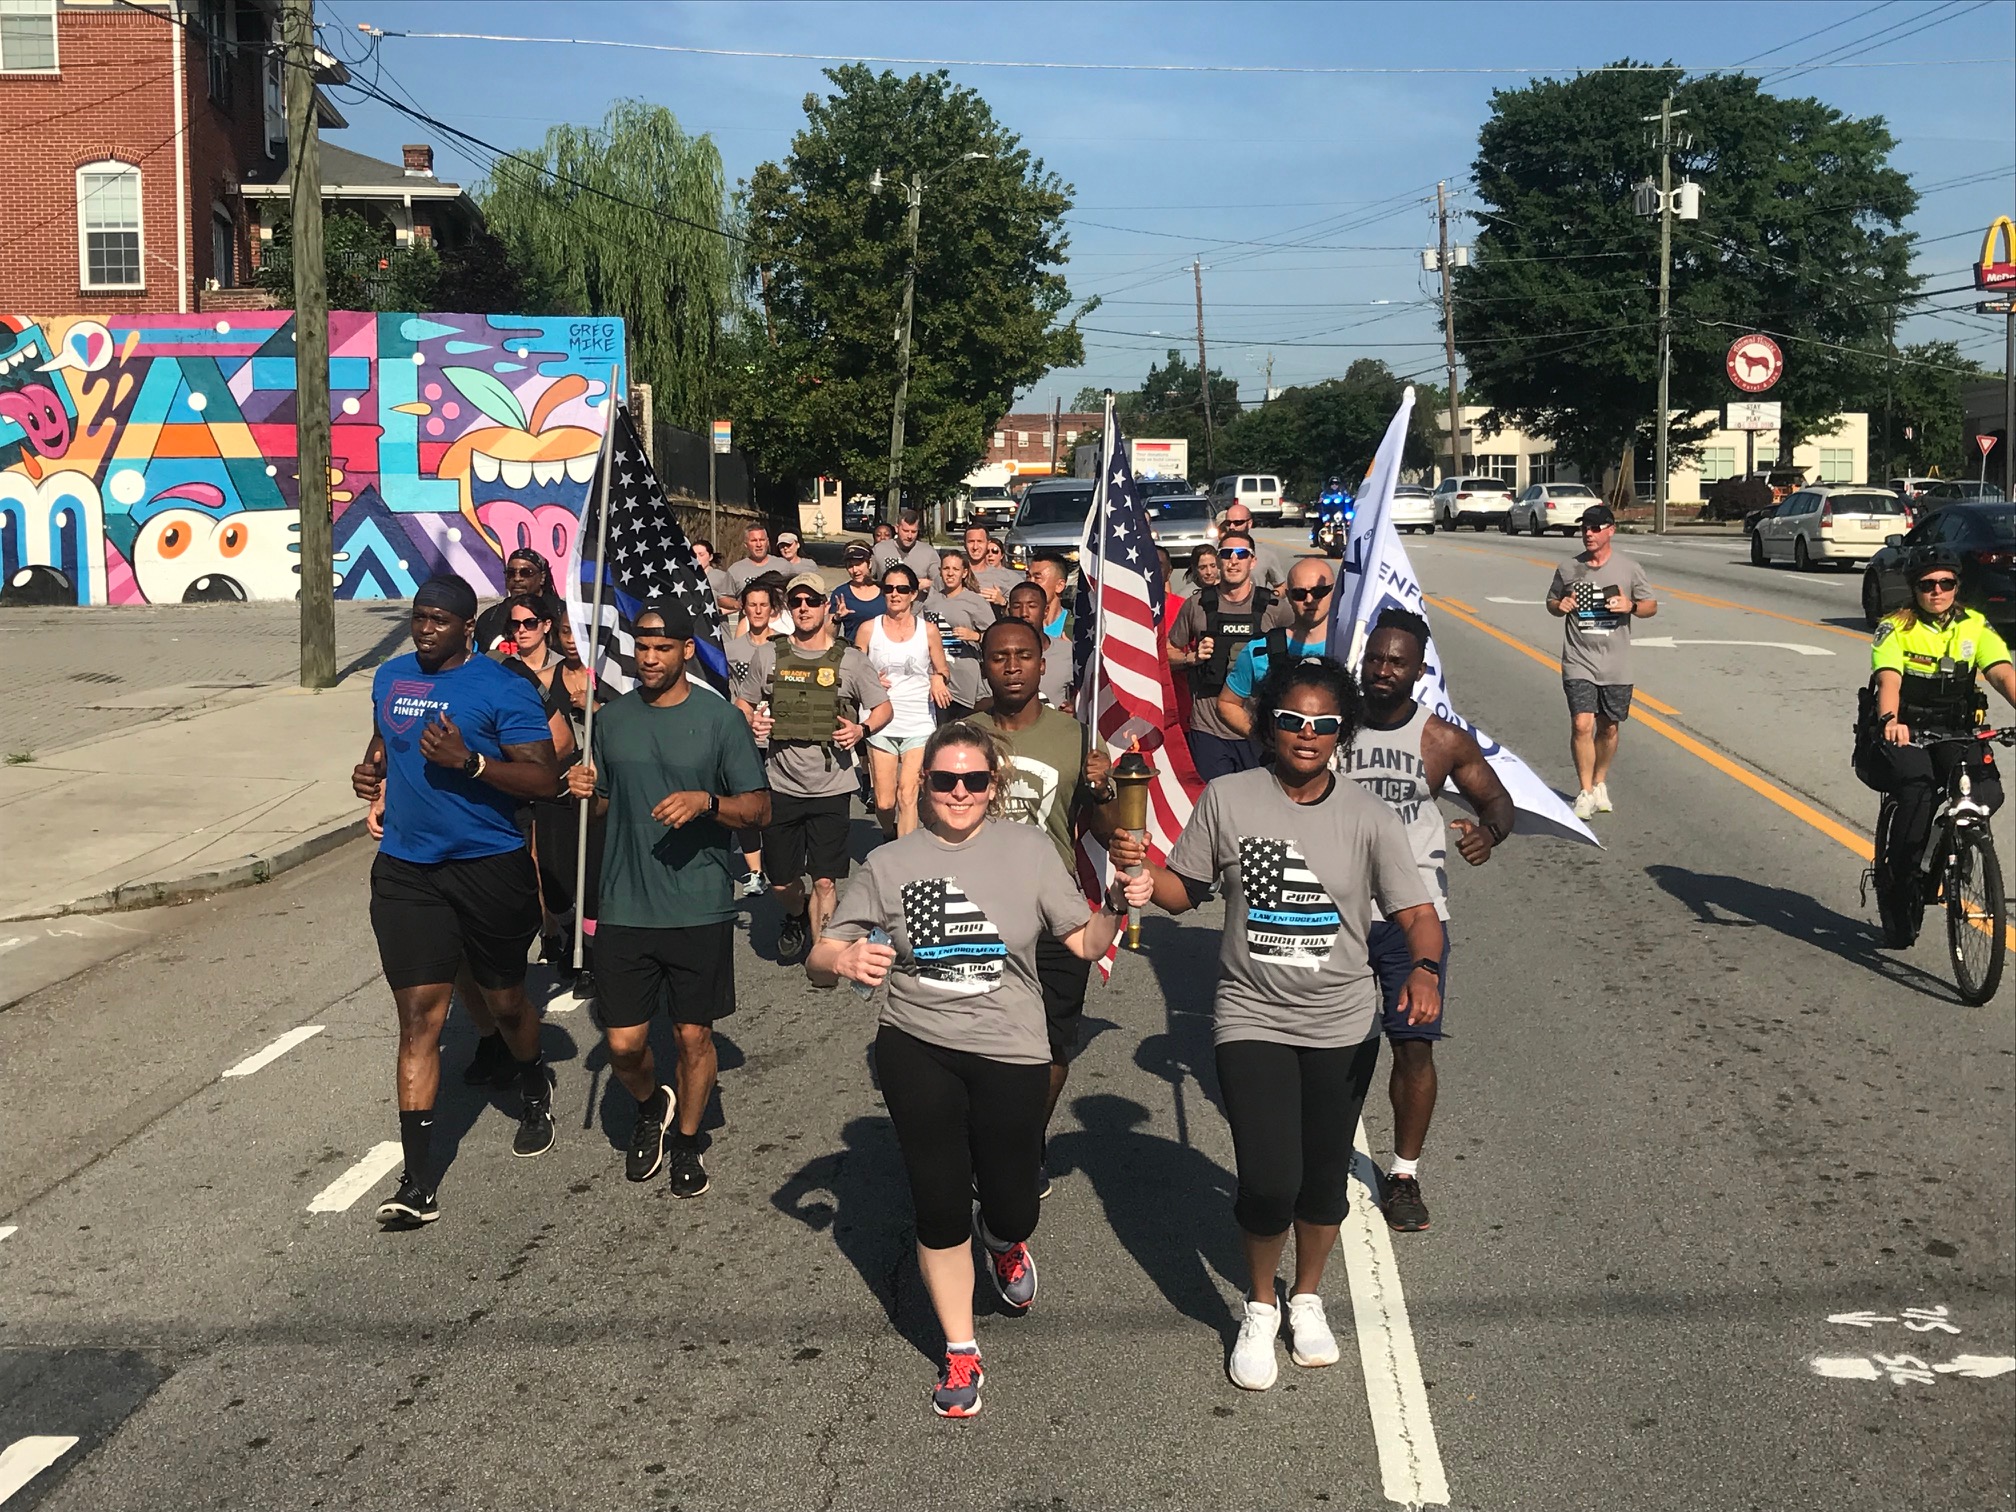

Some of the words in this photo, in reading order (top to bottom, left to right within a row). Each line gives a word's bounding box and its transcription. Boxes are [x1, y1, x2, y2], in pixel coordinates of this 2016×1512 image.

[570, 324, 615, 337] GREG
[570, 337, 616, 353] MIKE
[1733, 336, 1755, 352] Animal
[1757, 336, 1777, 353] House
[1223, 625, 1250, 633] POLICE
[395, 697, 449, 710] ATLANTA'S
[393, 706, 425, 717] FINEST
[1338, 748, 1427, 779] TLANTA
[1285, 893, 1321, 902] 2019
[1253, 912, 1273, 920] LAW
[1273, 914, 1336, 922] ENFORCEMENT
[949, 924, 984, 933] 2019
[1254, 934, 1296, 945] TORCH
[1300, 937, 1328, 946] RUN
[938, 947, 1001, 955] ENFORCEMENT
[969, 965, 995, 973] RUN
